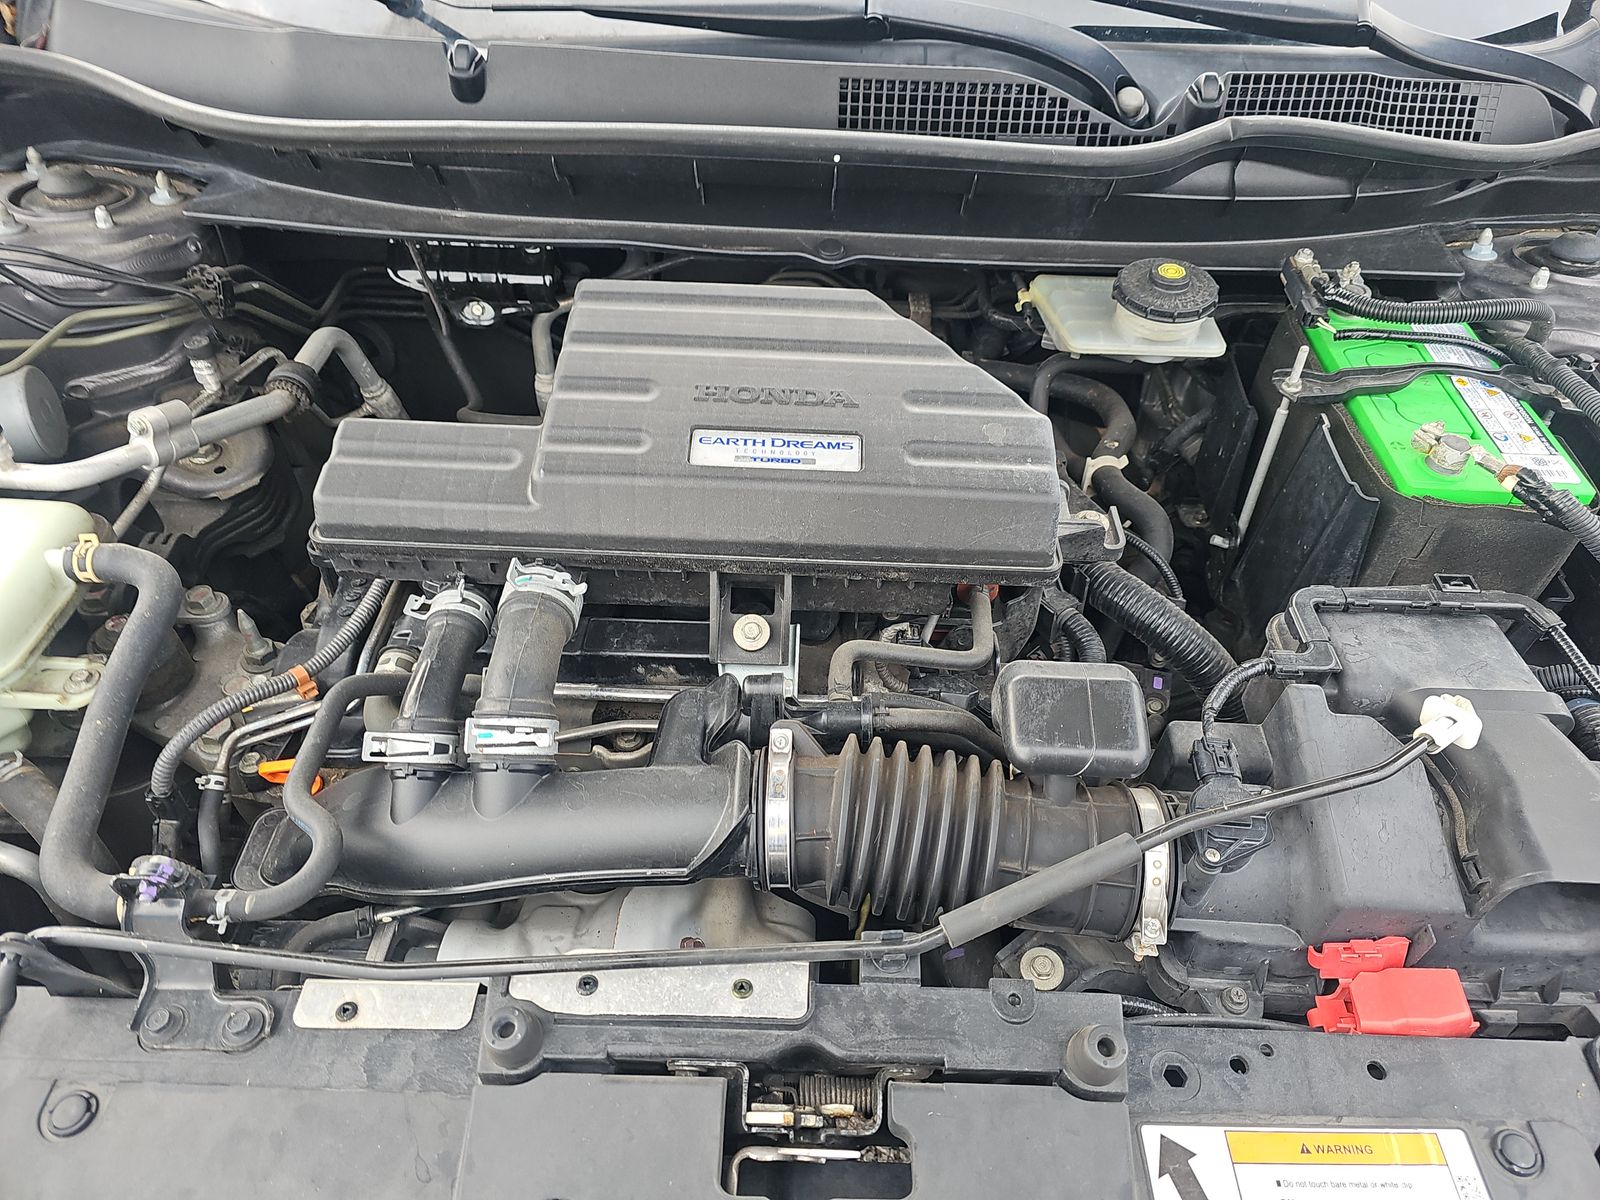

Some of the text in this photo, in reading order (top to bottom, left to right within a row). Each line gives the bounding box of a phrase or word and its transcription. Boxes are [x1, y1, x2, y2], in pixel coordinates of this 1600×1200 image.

[693, 384, 860, 408] HONDA
[698, 436, 854, 451] EARTH DREAMS
[735, 448, 816, 456] TECHNOLOGY
[751, 456, 801, 464] TURBO
[1313, 1144, 1374, 1155] WARNING
[1282, 1179, 1294, 1188] Do
[1295, 1180, 1308, 1189] not
[1308, 1180, 1329, 1189] touch
[1330, 1180, 1348, 1189] bare
[1348, 1181, 1369, 1189] metal
